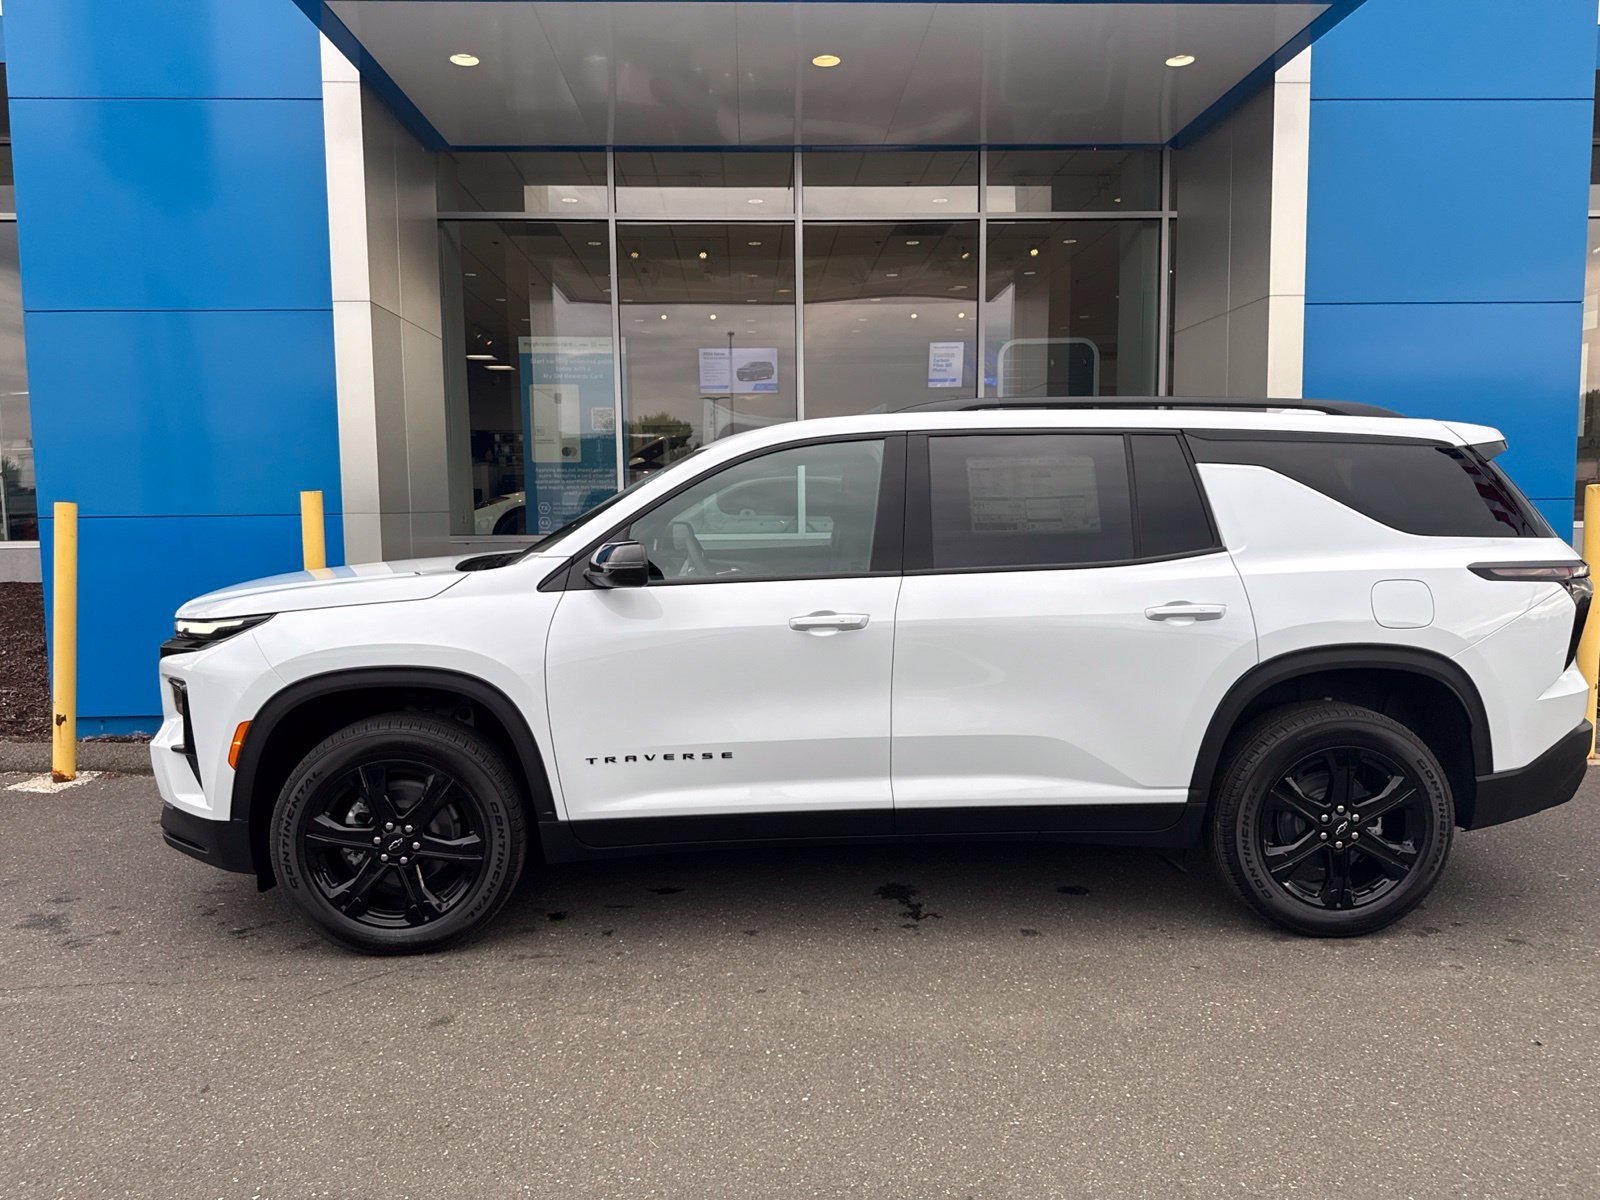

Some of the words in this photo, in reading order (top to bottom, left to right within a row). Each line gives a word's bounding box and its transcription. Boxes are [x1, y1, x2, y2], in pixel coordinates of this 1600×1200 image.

[585, 752, 734, 765] TRAVERSE
[1415, 757, 1448, 873] CONTINENTAL
[279, 769, 323, 889] CONTINENTAL
[465, 801, 511, 921] CONTINENTAL
[1239, 787, 1273, 901] CONTINENTAL
